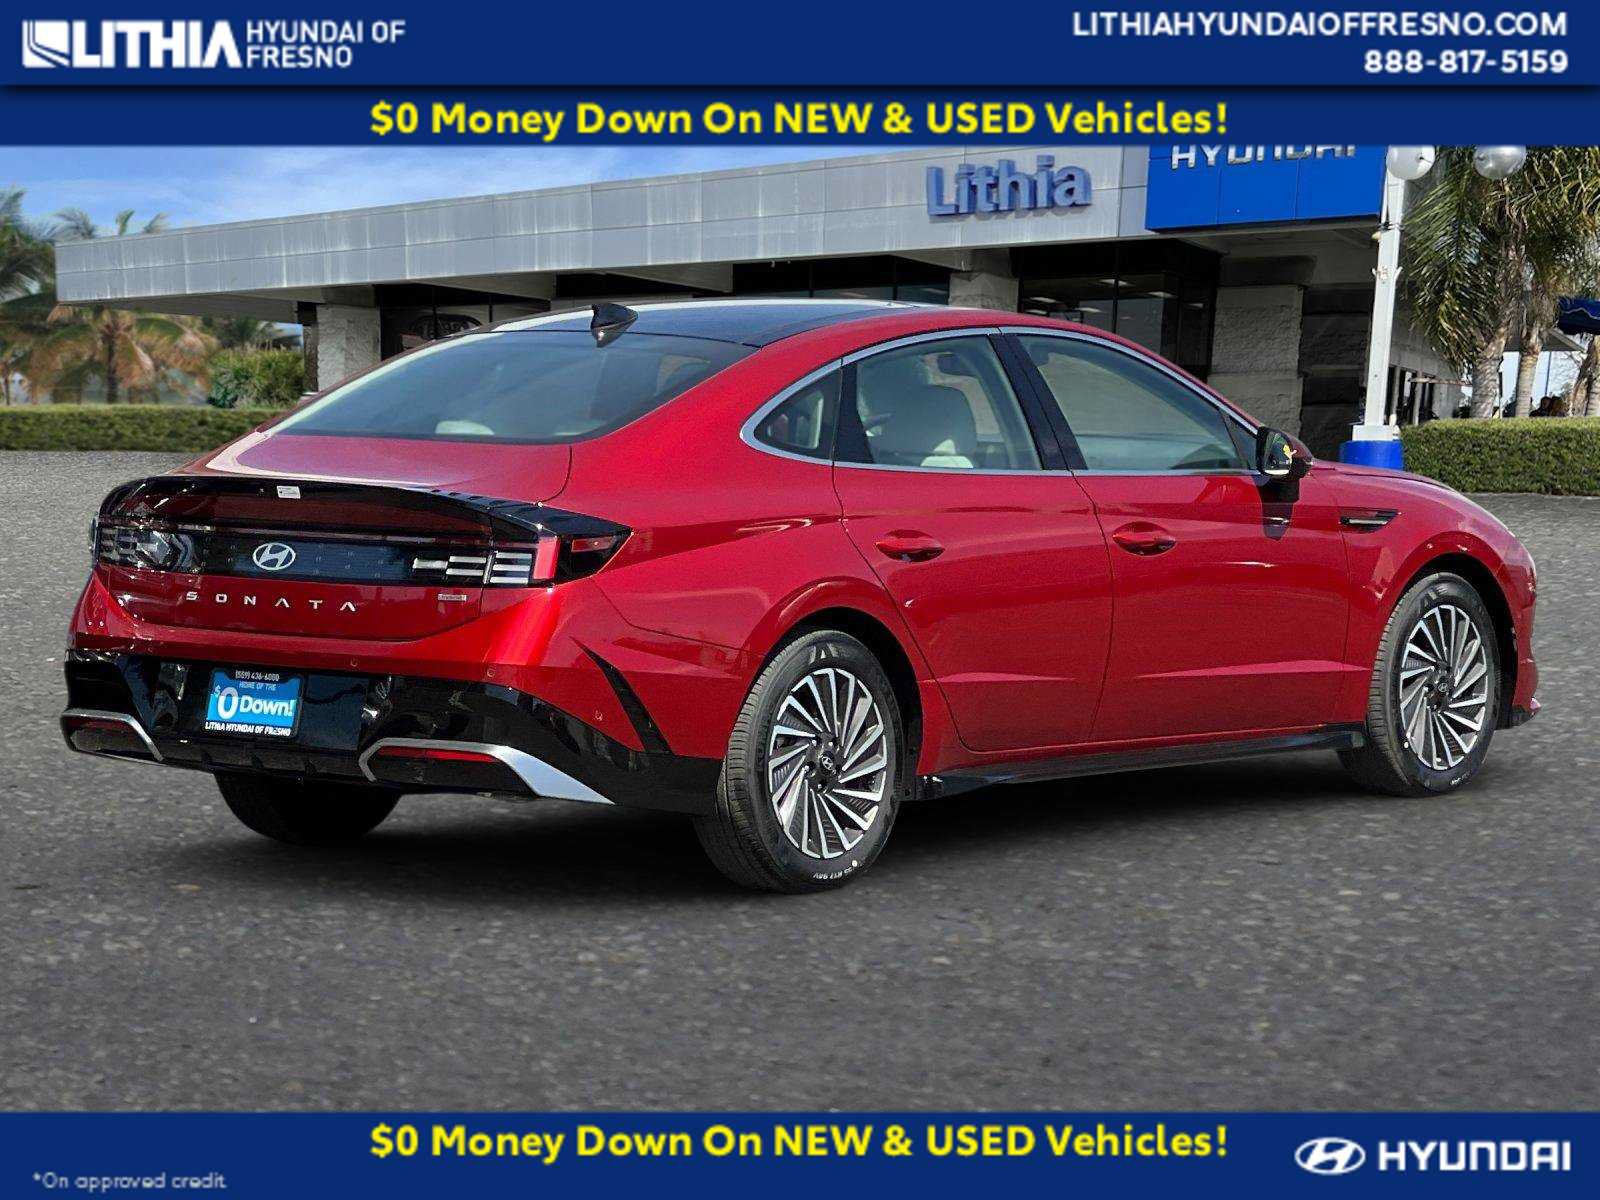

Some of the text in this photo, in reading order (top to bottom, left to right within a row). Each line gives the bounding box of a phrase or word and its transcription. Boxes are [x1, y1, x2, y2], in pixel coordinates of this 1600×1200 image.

[926, 155, 1092, 216] Lithia
[186, 591, 356, 612] SONATA
[240, 695, 297, 717] Down!
